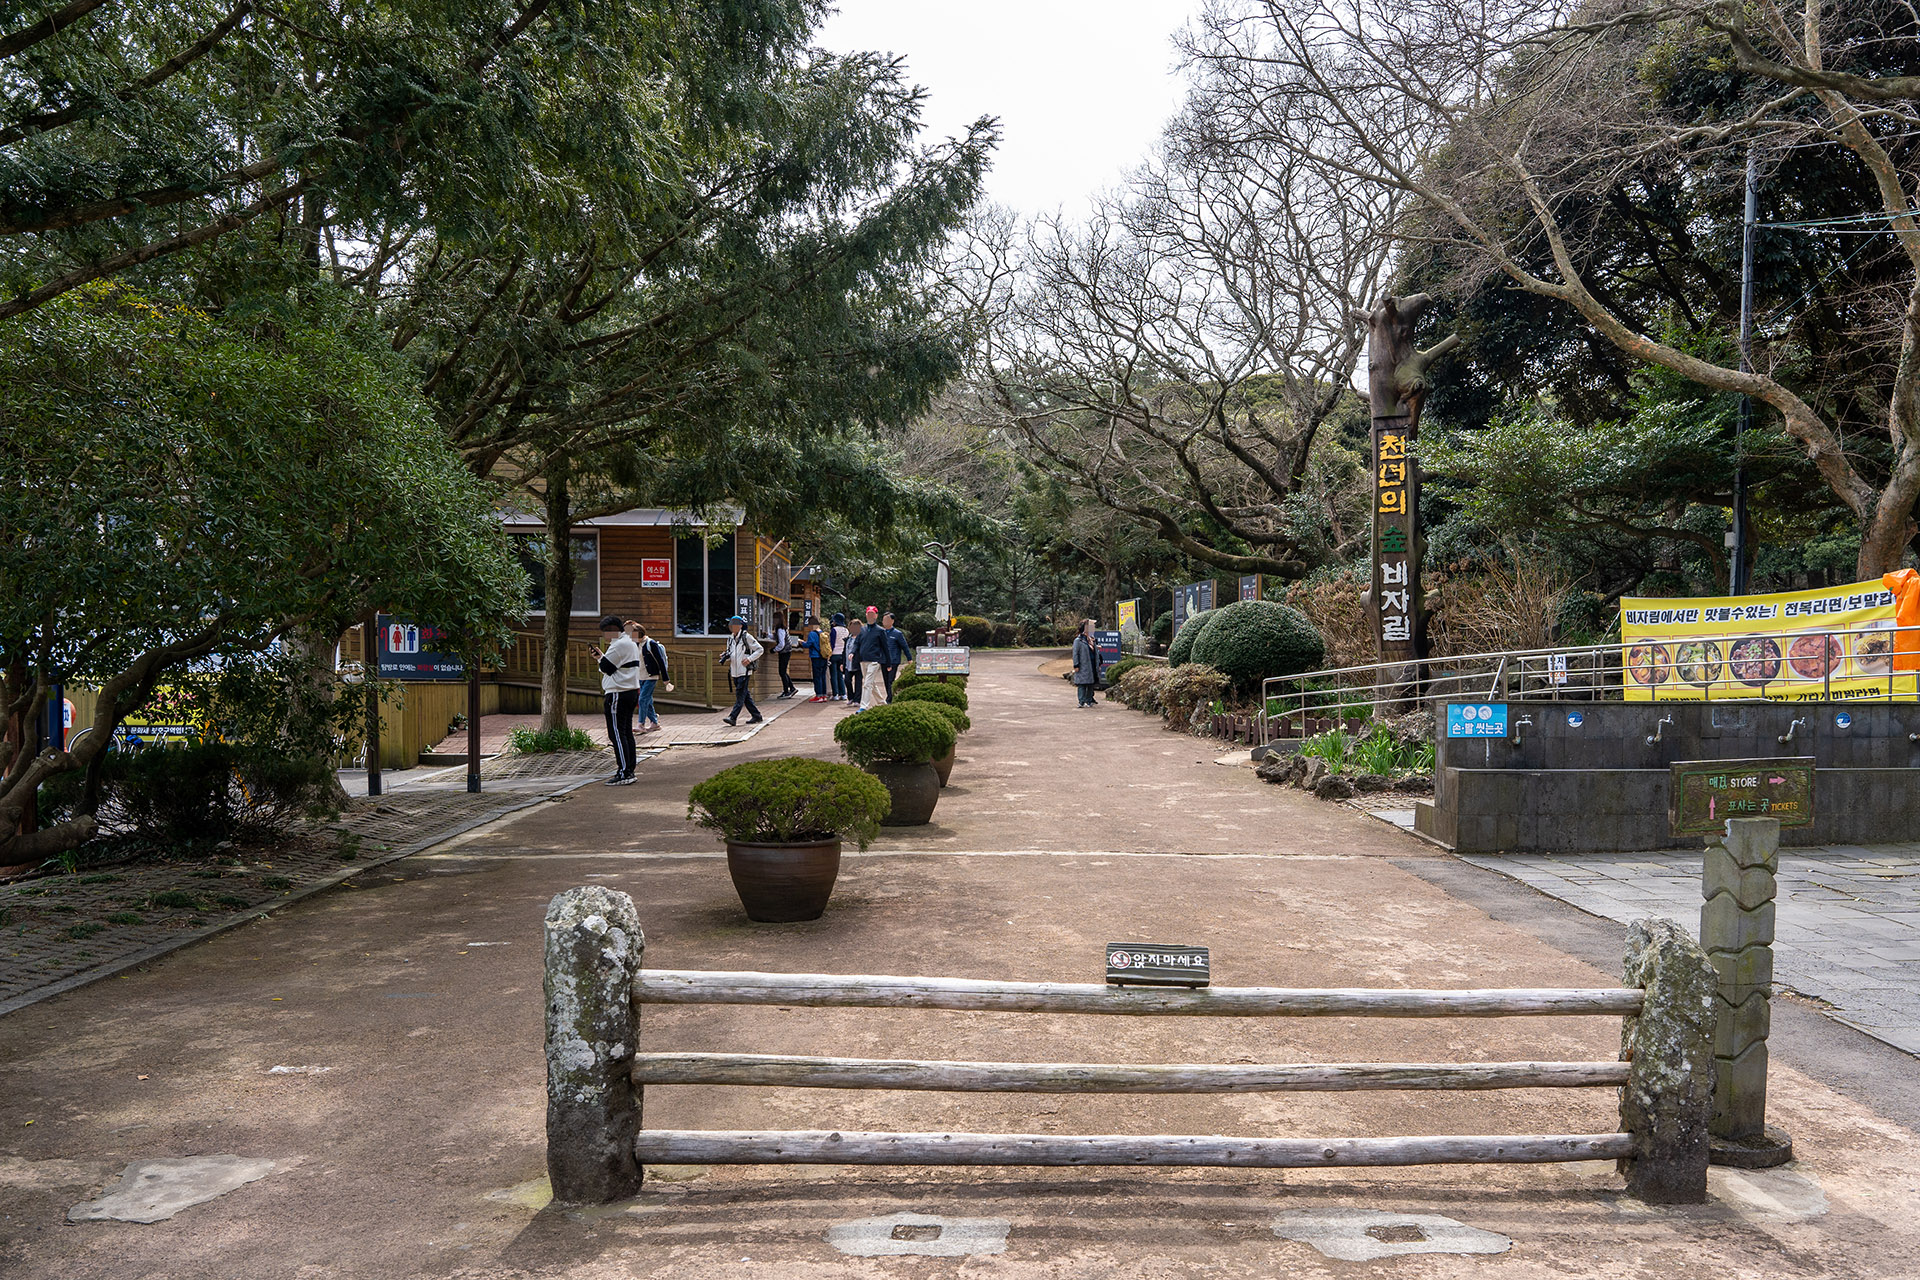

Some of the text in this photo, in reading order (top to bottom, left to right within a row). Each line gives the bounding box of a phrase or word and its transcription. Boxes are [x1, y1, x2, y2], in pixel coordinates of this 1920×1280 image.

[1379, 434, 1411, 642] 천년의 숲 비자림
[647, 566, 665, 574] 에스원
[1626, 592, 1896, 625] 비자림에서만 맛볼수있는! 전복라면/보말컵
[381, 664, 398, 672] 탐방로
[399, 664, 416, 672] 안에는
[440, 664, 464, 672] 없습니다.
[1452, 722, 1504, 735] 손·발 씻는곳
[1709, 776, 1757, 790] 매점 STORE
[1728, 798, 1798, 812] 표사는 곳 TICKETS
